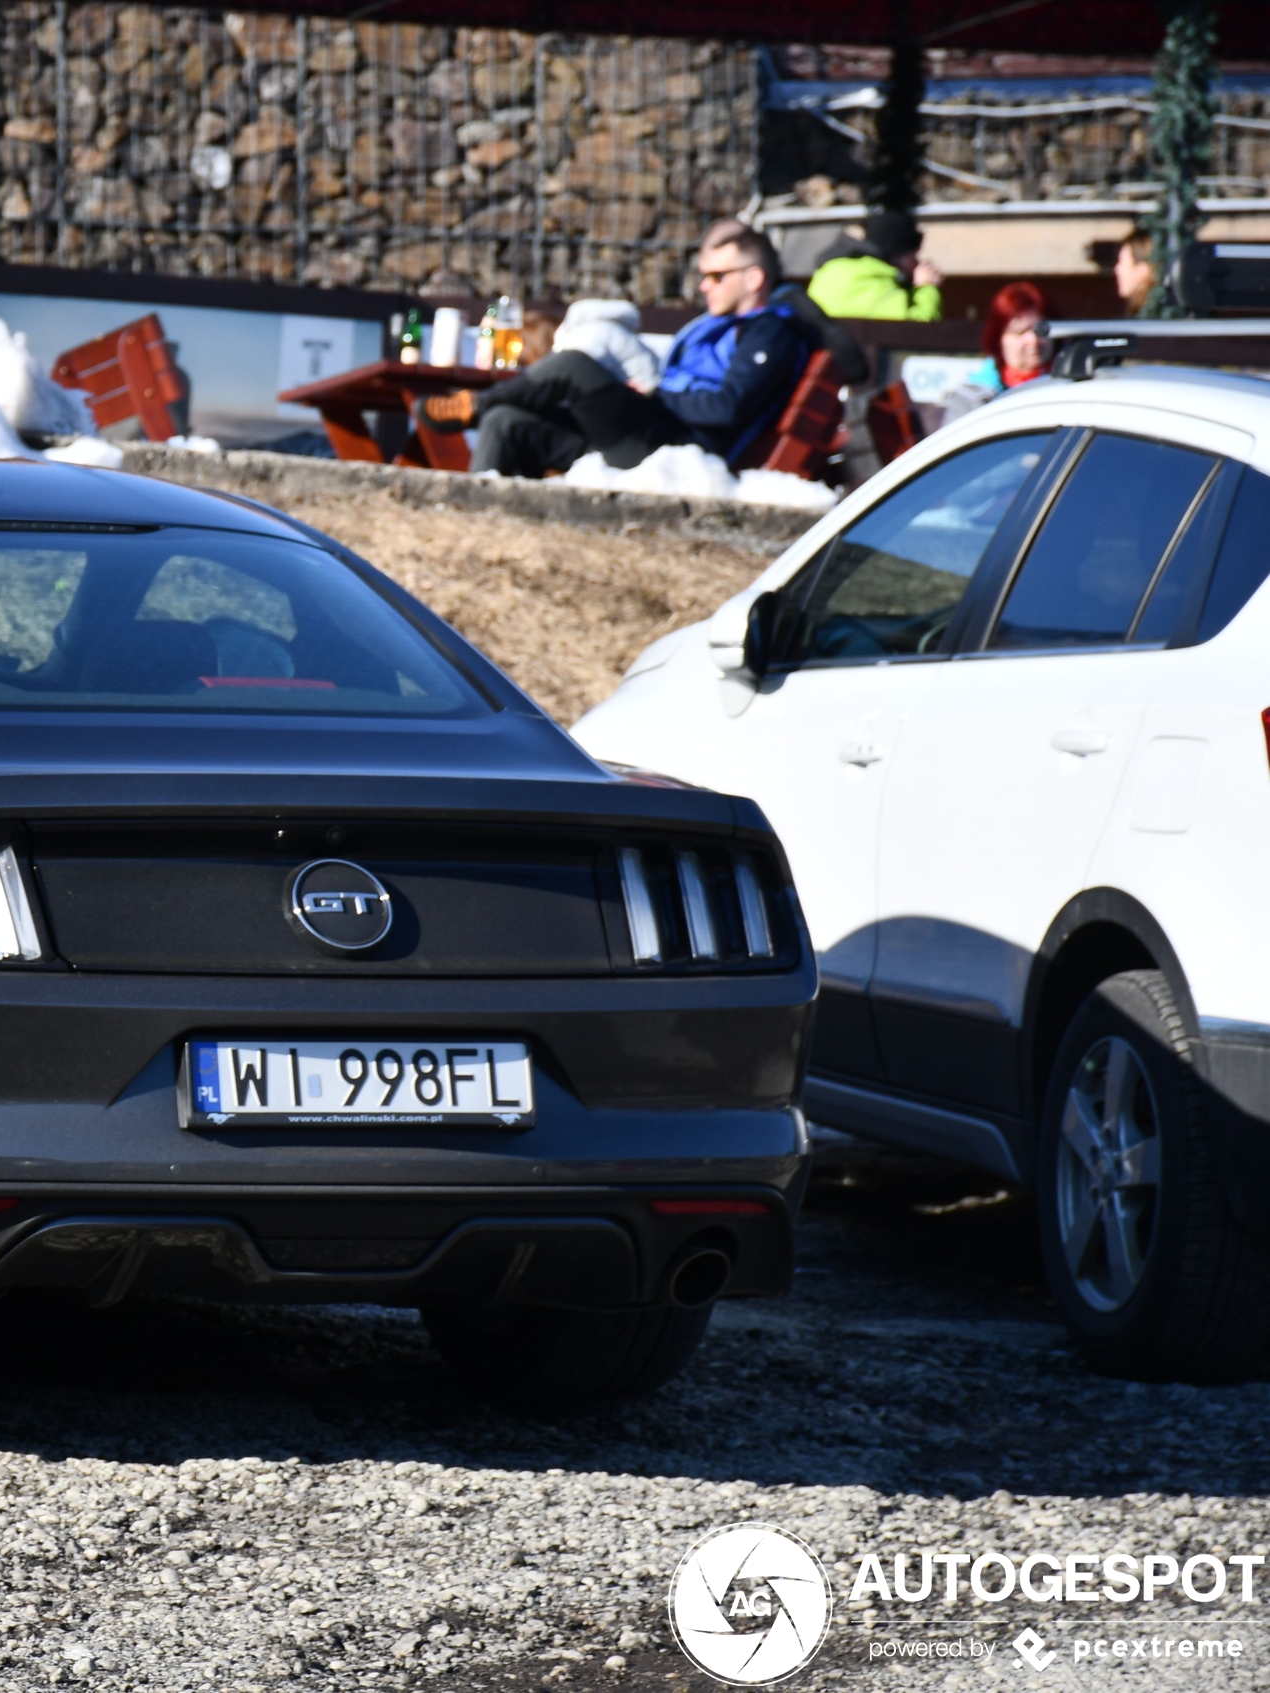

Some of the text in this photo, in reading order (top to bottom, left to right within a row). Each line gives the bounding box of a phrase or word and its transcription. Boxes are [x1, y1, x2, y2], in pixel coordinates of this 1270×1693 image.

[302, 892, 378, 914] GT
[229, 1048, 521, 1107] WI 998FL
[197, 1087, 218, 1103] PL
[288, 1114, 443, 1123] www.chwalinski.com.pl
